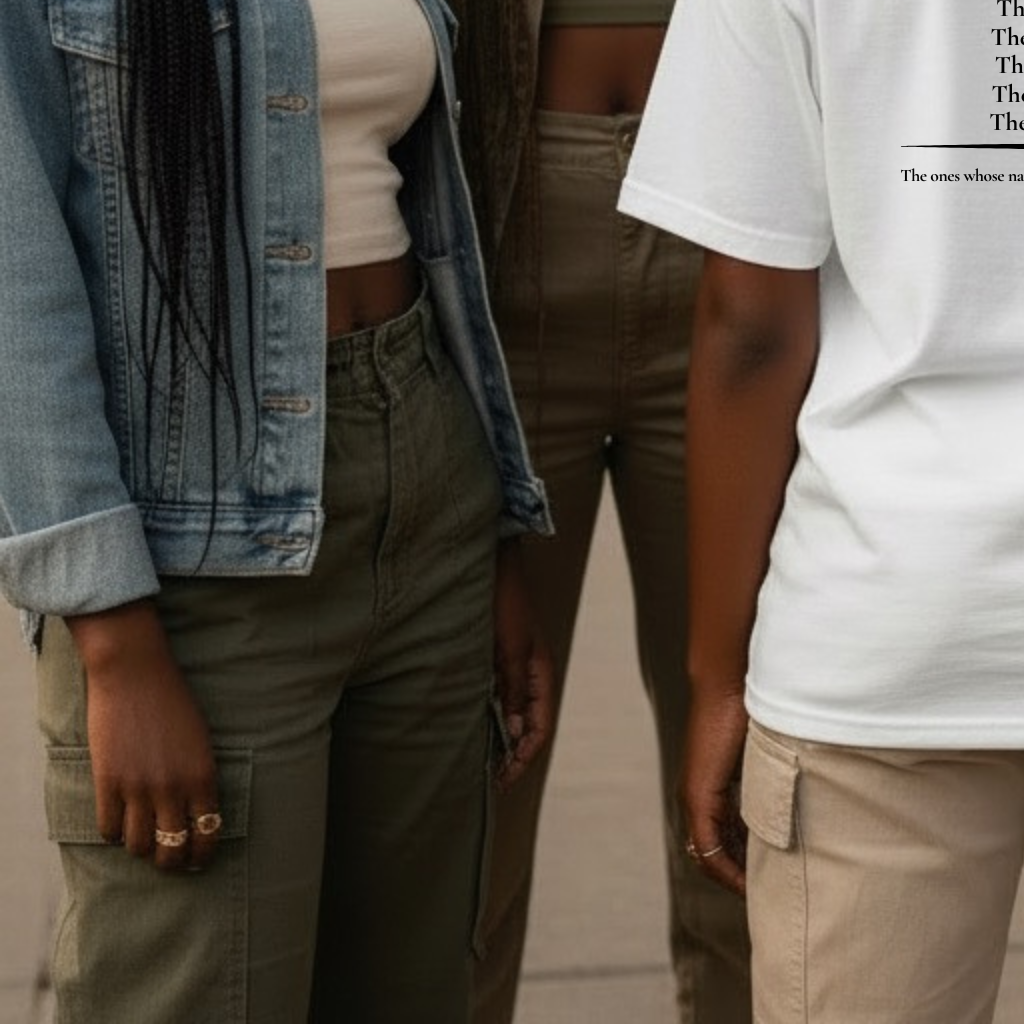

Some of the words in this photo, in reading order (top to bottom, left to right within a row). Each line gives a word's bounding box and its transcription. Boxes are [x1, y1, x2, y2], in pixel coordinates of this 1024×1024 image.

[900, 167, 928, 182] The
[930, 173, 961, 182] ones
[963, 167, 1005, 182] whose
